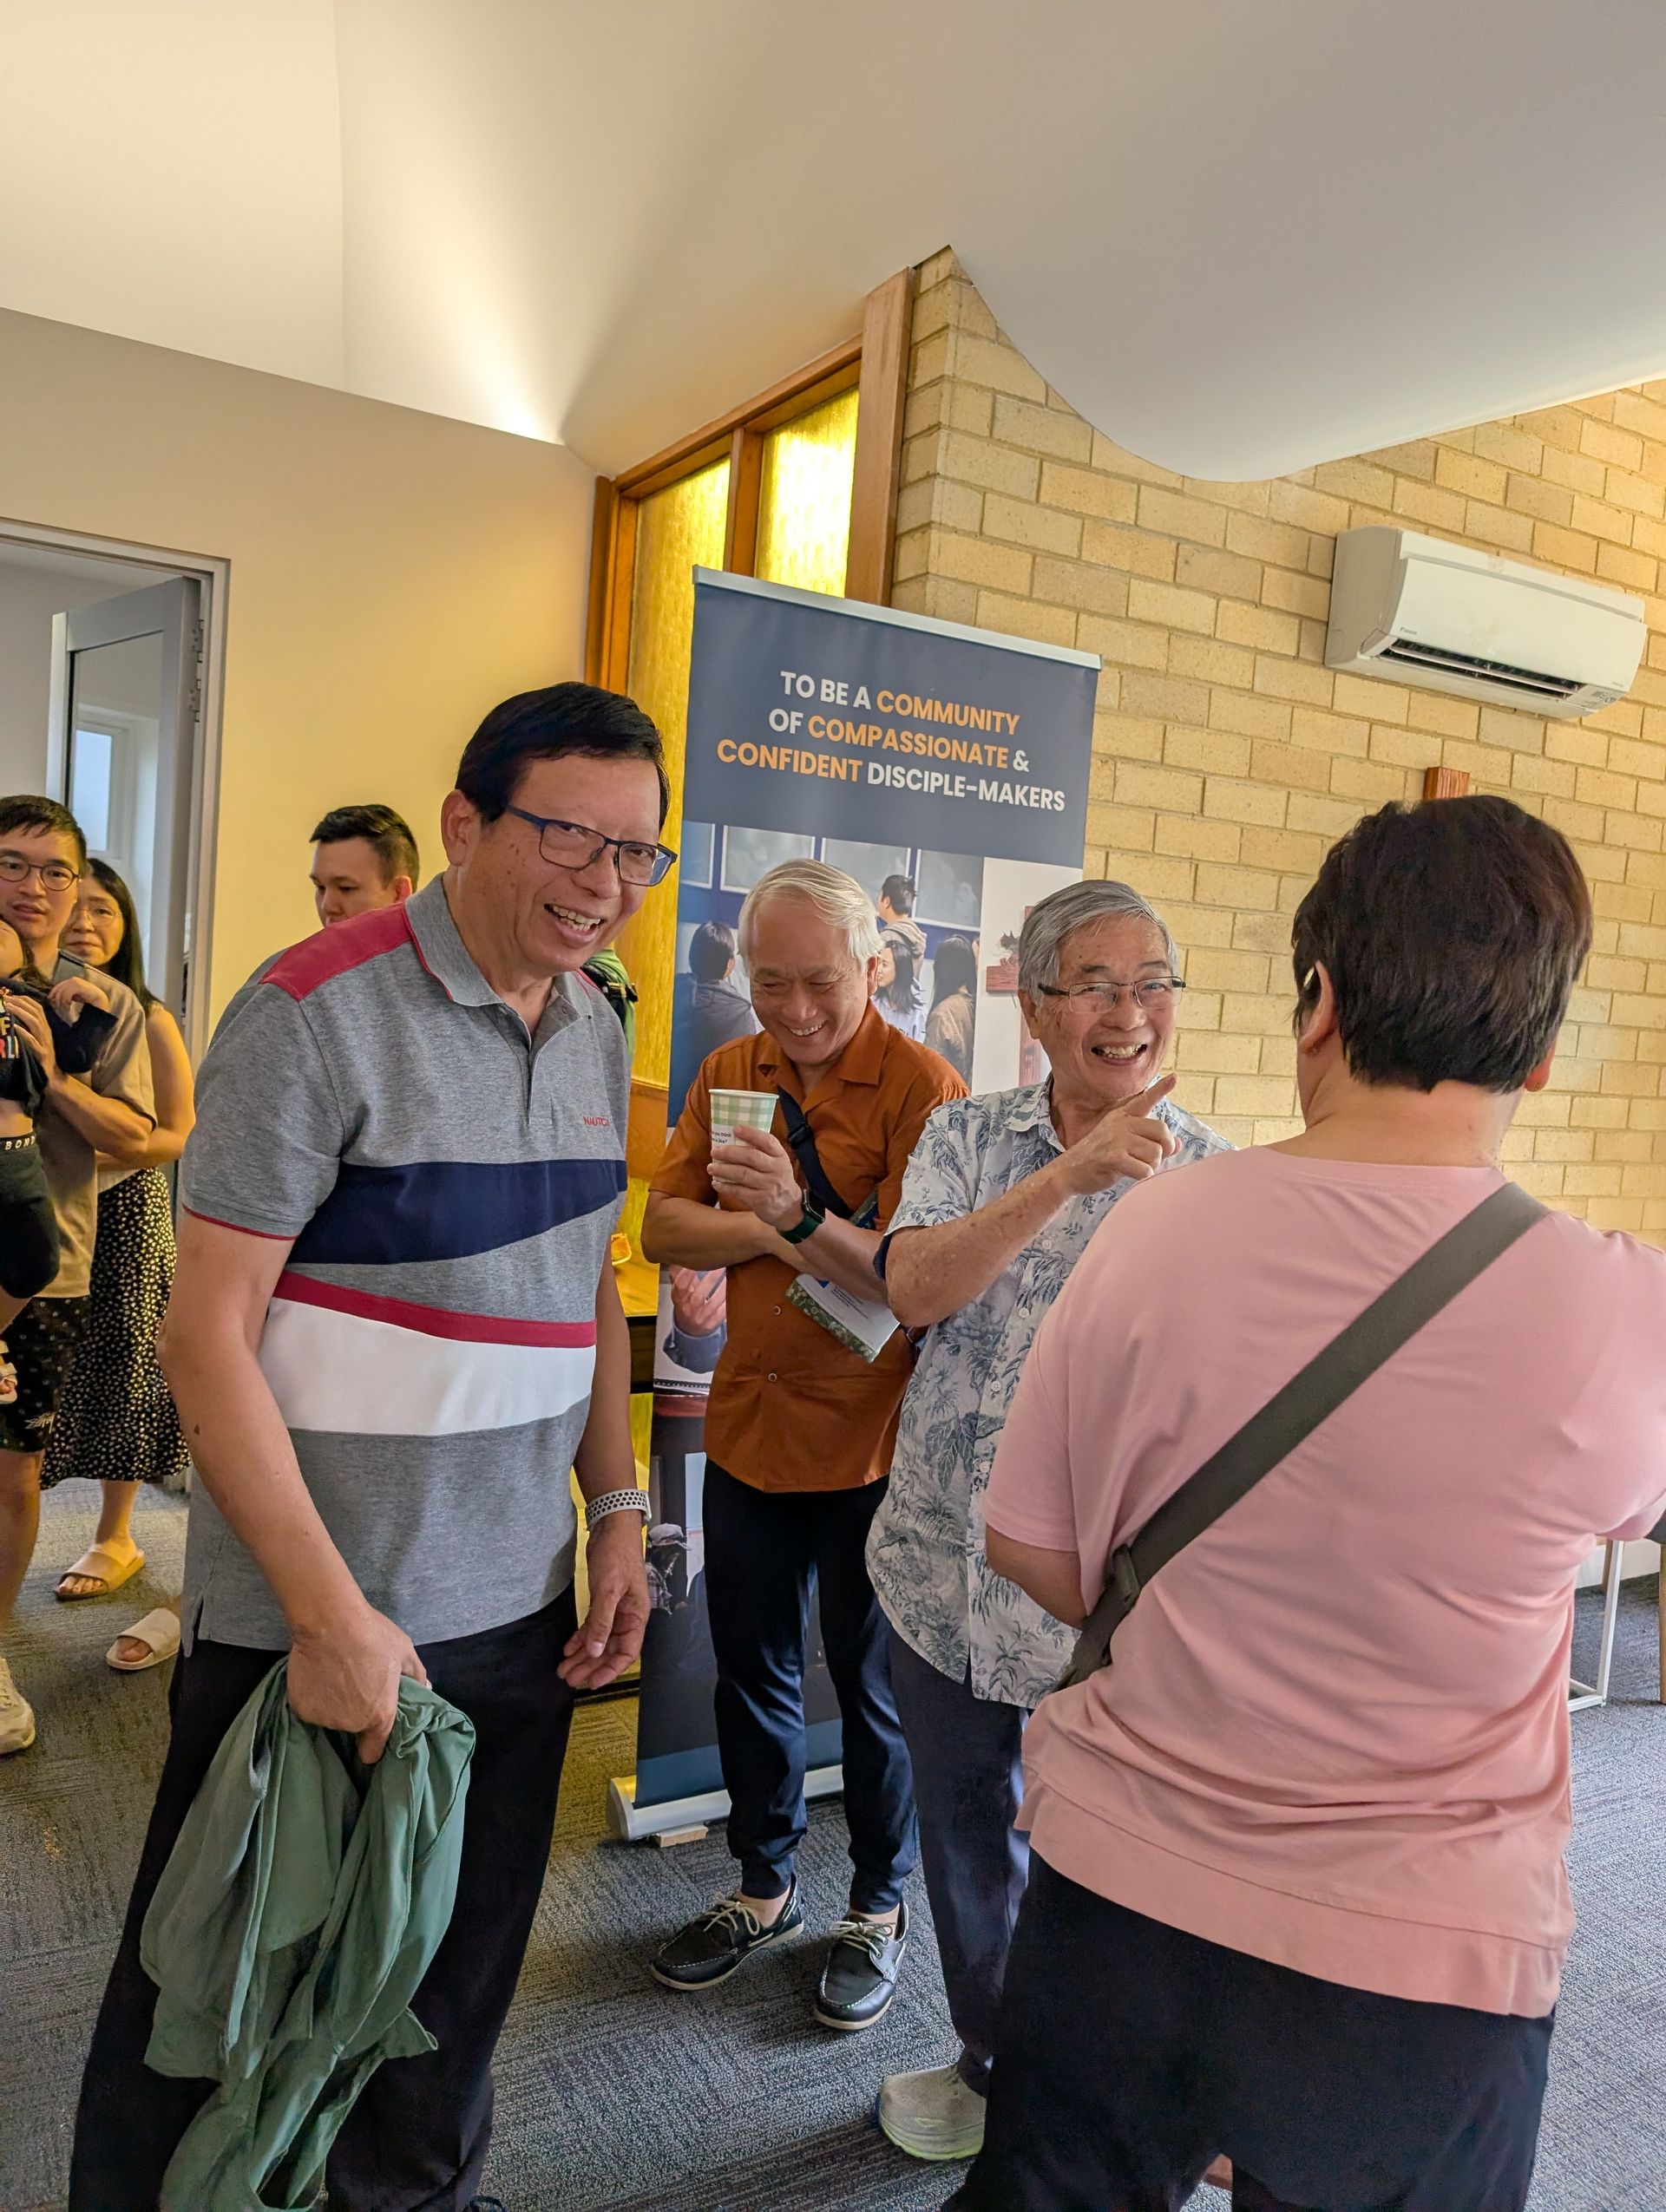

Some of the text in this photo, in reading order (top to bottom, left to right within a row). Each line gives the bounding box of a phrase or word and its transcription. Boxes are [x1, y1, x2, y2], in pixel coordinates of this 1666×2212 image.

[780, 671, 1020, 736] TO BE A COMMUNITY
[769, 708, 1030, 772] OF COMPASSIONATE &
[717, 738, 1066, 812] CONFIDENT DISCIPLE-MAKERS
